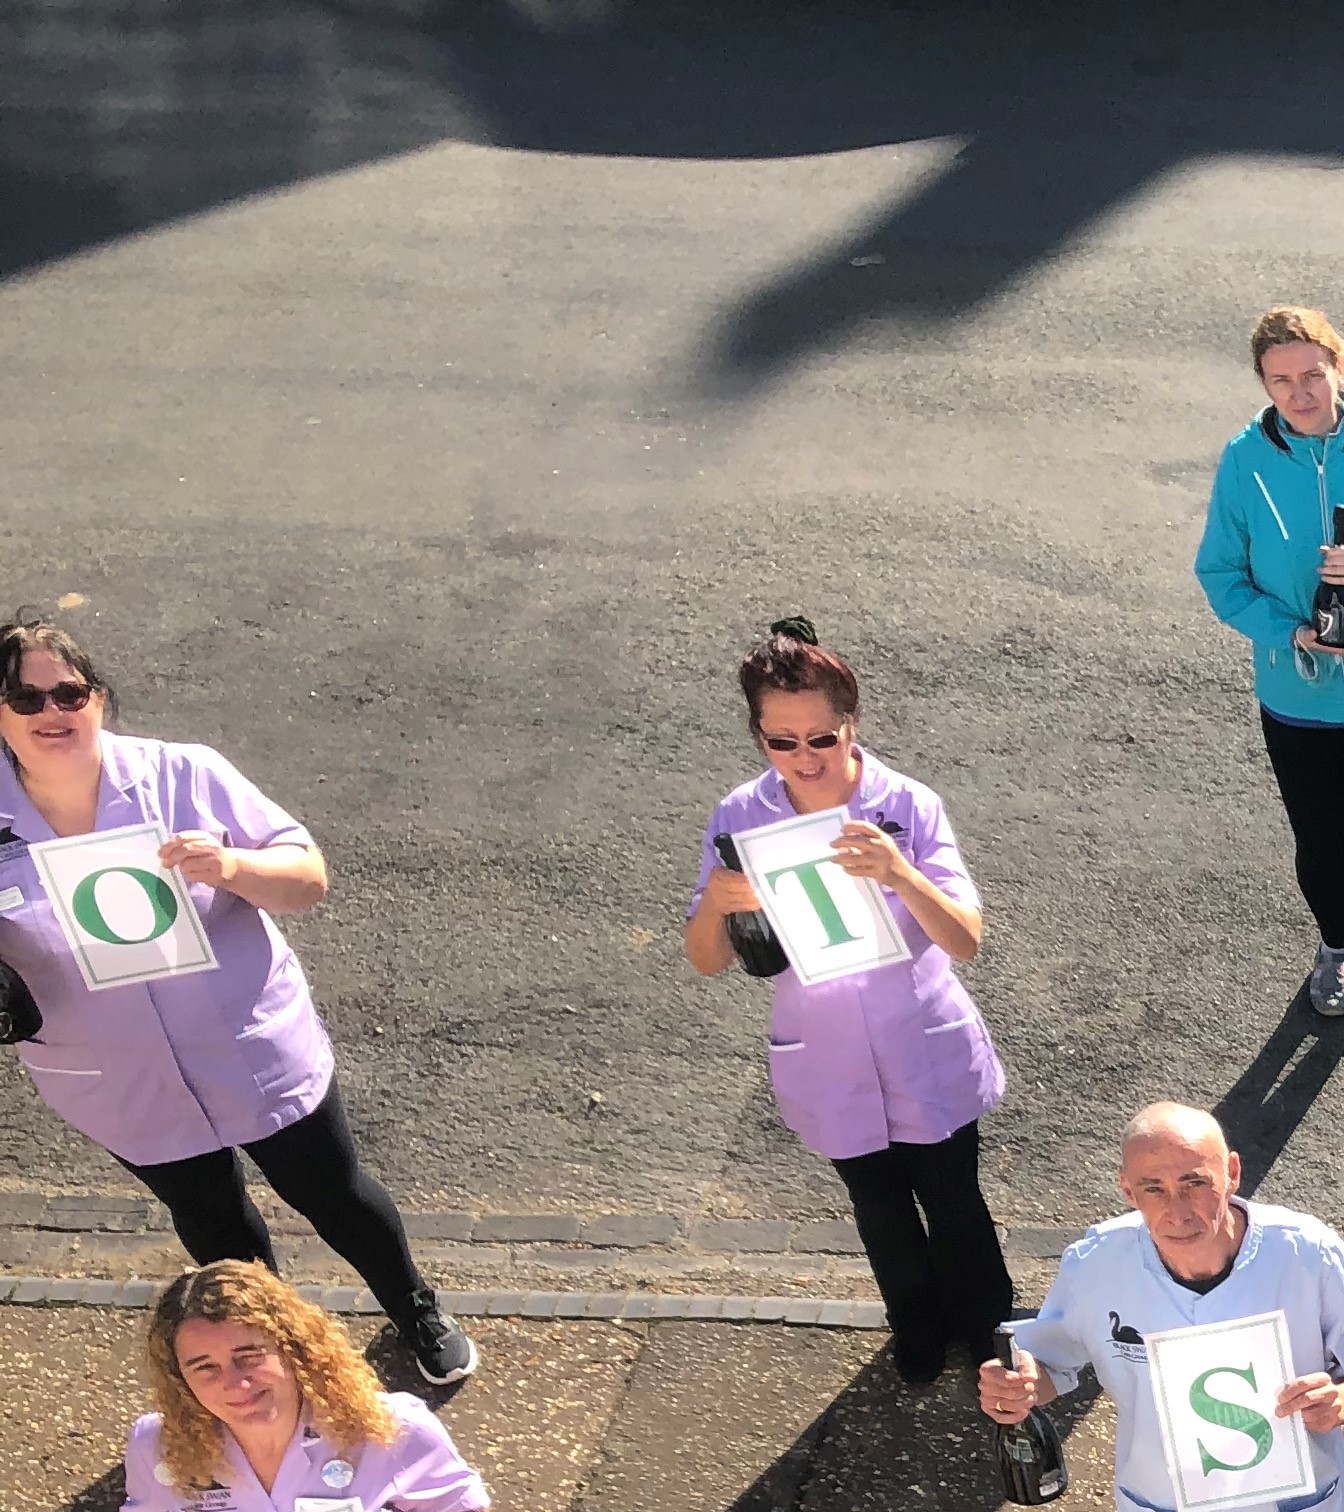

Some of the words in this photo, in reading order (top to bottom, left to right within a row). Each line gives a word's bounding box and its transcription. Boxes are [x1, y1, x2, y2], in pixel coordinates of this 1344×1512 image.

[72, 866, 178, 944] O
[765, 853, 866, 949] T
[1190, 1362, 1274, 1477] S
